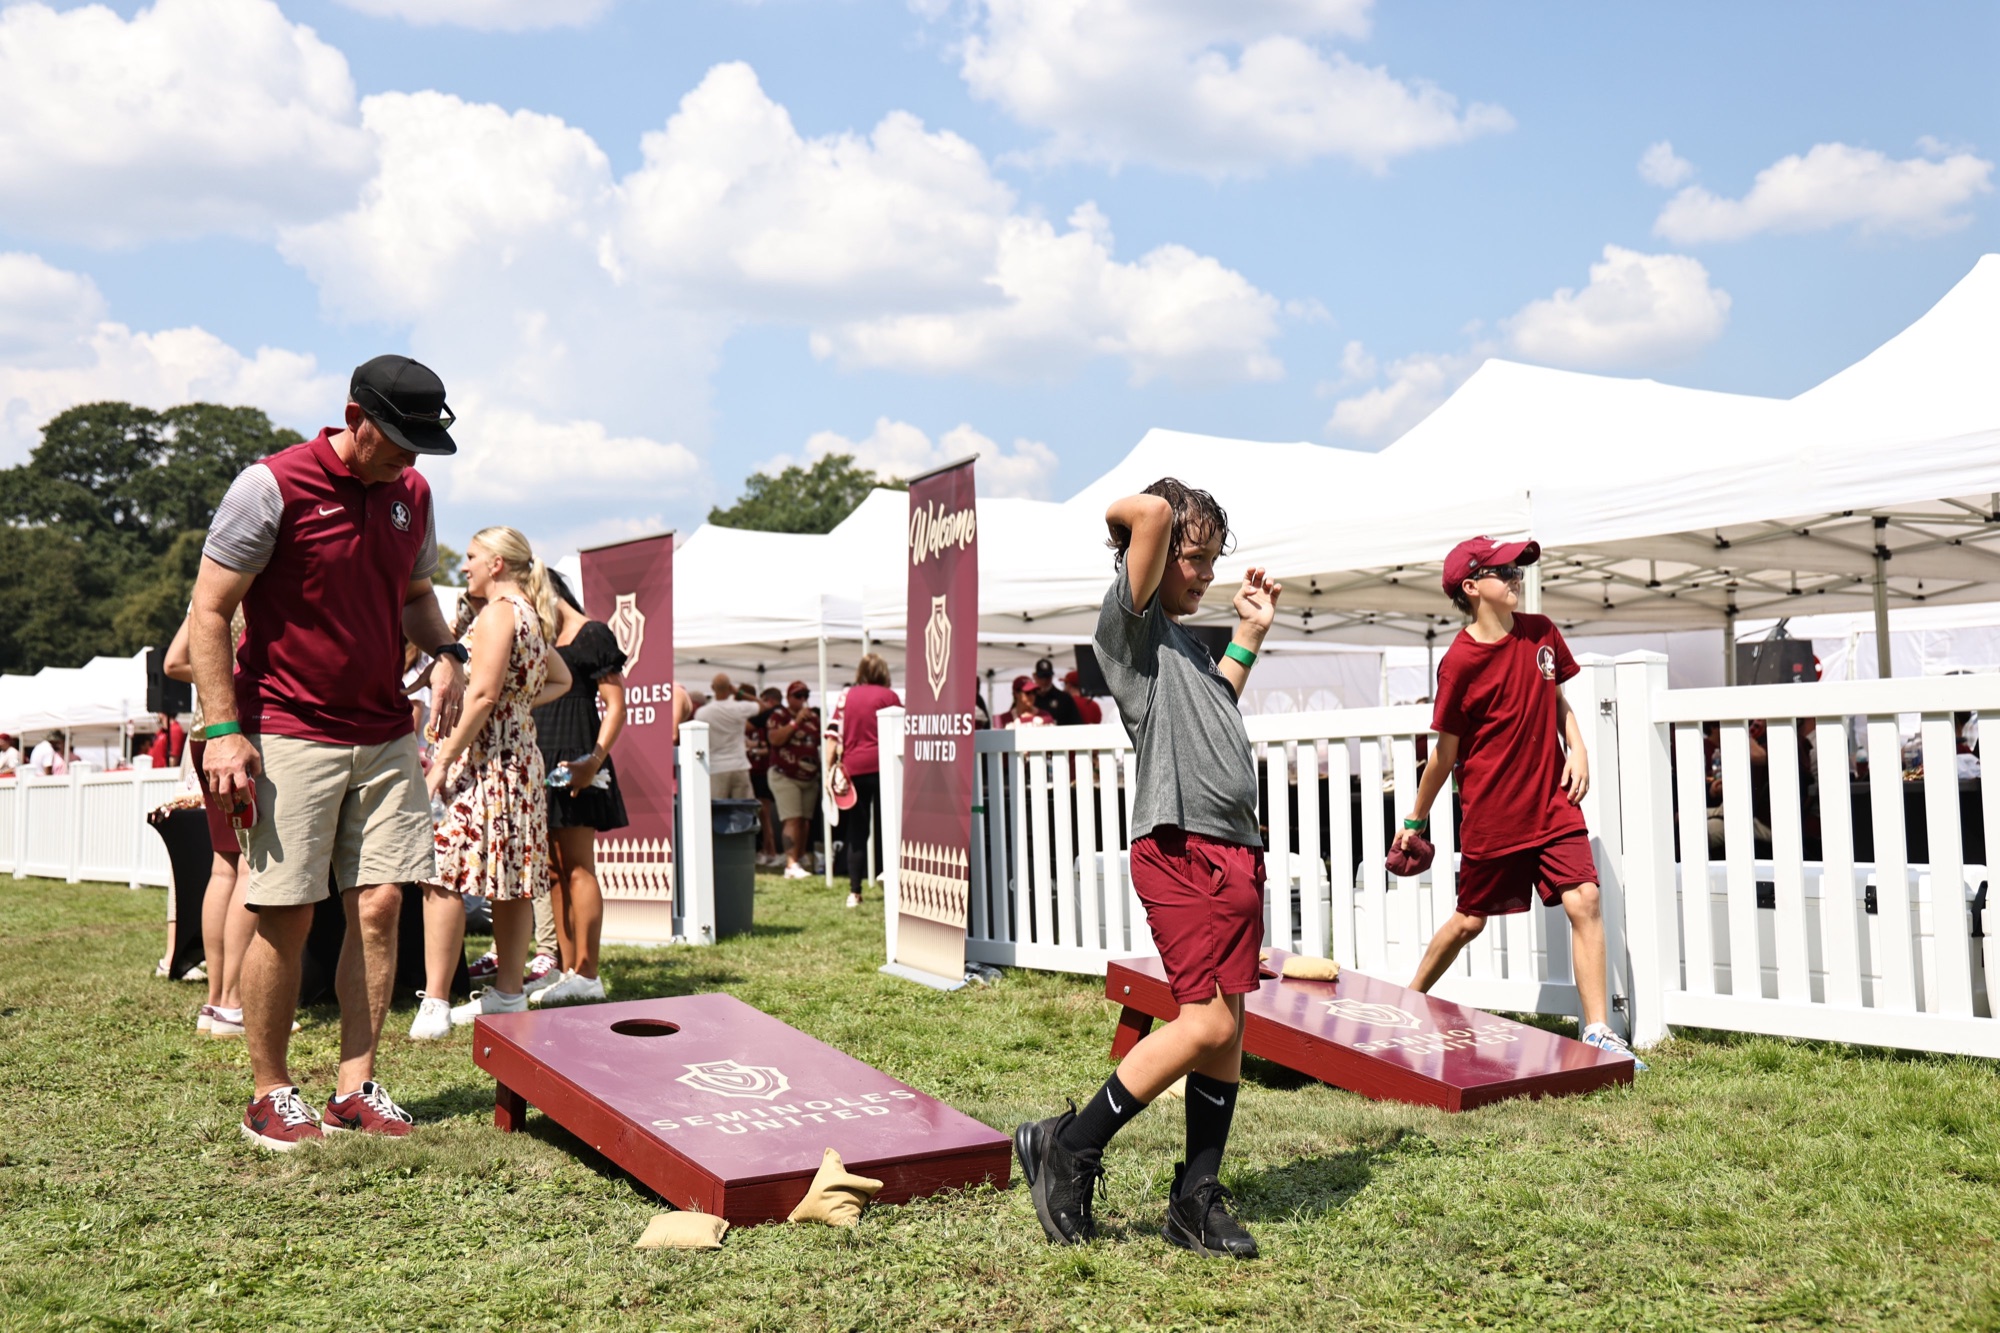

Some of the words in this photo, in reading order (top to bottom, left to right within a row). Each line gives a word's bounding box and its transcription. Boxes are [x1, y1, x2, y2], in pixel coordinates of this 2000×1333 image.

[910, 499, 976, 566] Welcome
[598, 706, 656, 726] TED
[905, 713, 973, 735] SEMINOLES
[914, 740, 957, 762] UNITED
[1353, 1021, 1524, 1051] SEMINOLES
[1404, 1033, 1519, 1055] UNITED
[651, 1089, 916, 1130] SEMINOLES
[715, 1105, 890, 1135] UNITED
